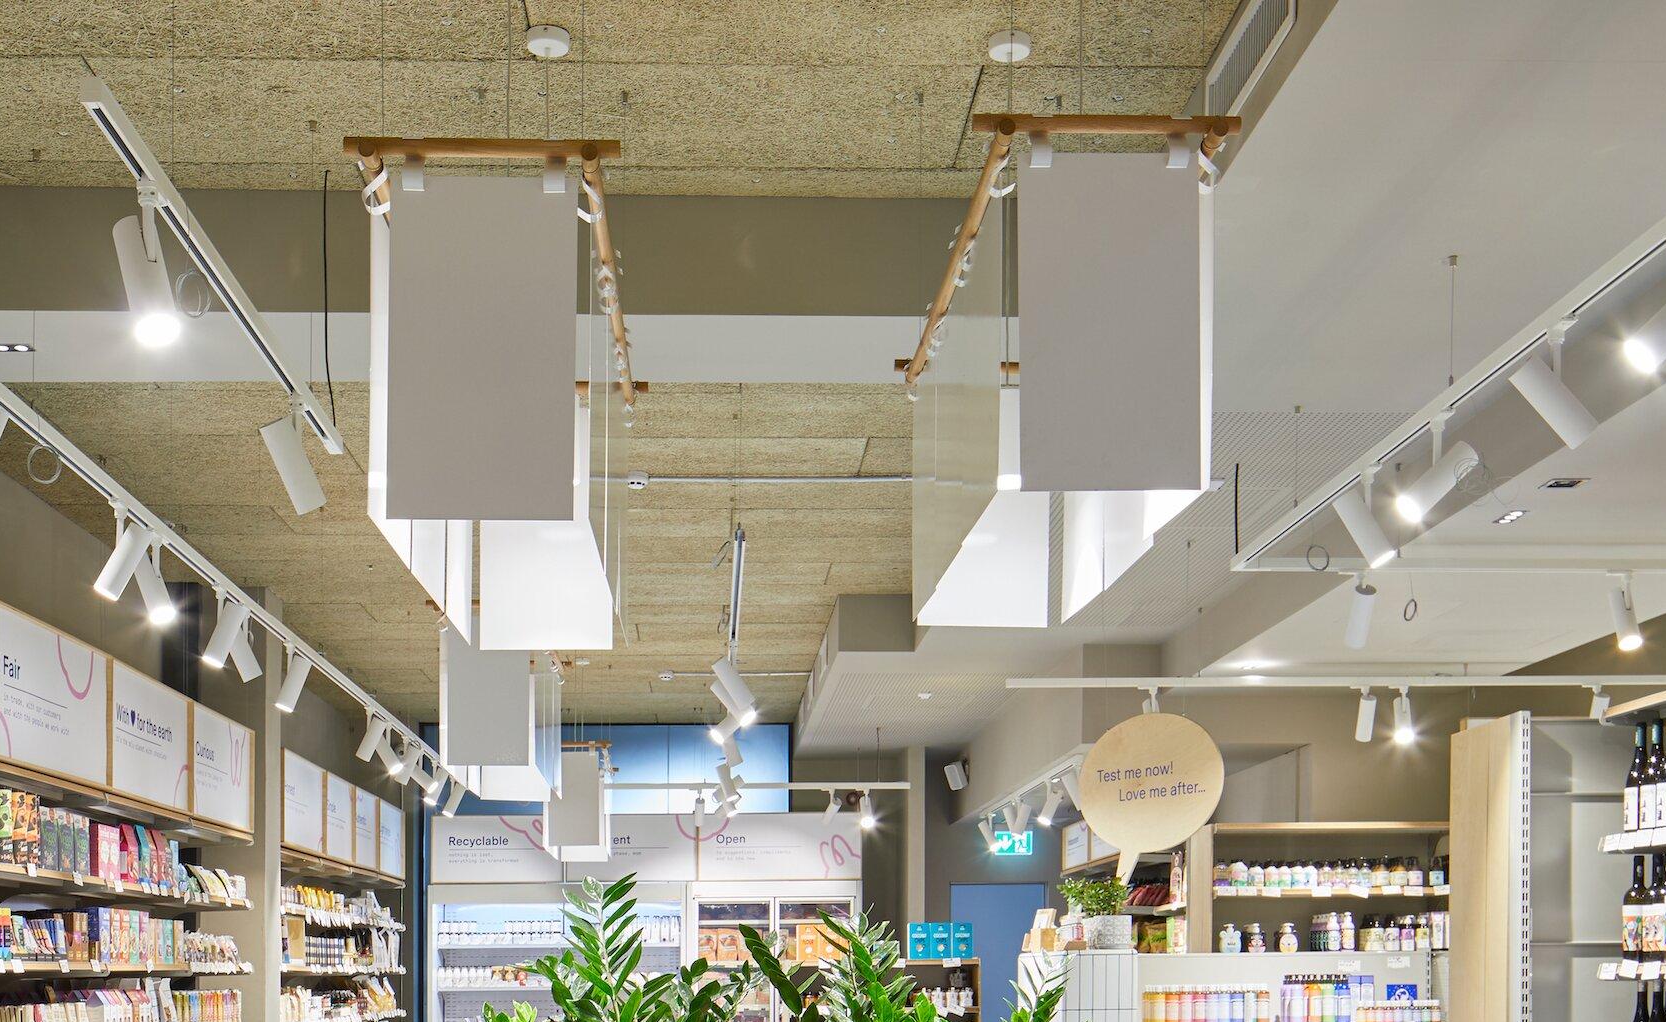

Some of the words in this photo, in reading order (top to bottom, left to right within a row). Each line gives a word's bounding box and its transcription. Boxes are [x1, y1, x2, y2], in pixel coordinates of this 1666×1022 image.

[3, 655, 21, 680] Fair
[1097, 768, 1121, 783] Test
[1124, 769, 1142, 780] me
[1145, 762, 1174, 778] now!
[1119, 788, 1146, 802] Love
[1149, 786, 1167, 798] me
[448, 836, 509, 848] Recyclable
[716, 834, 746, 846] Open
